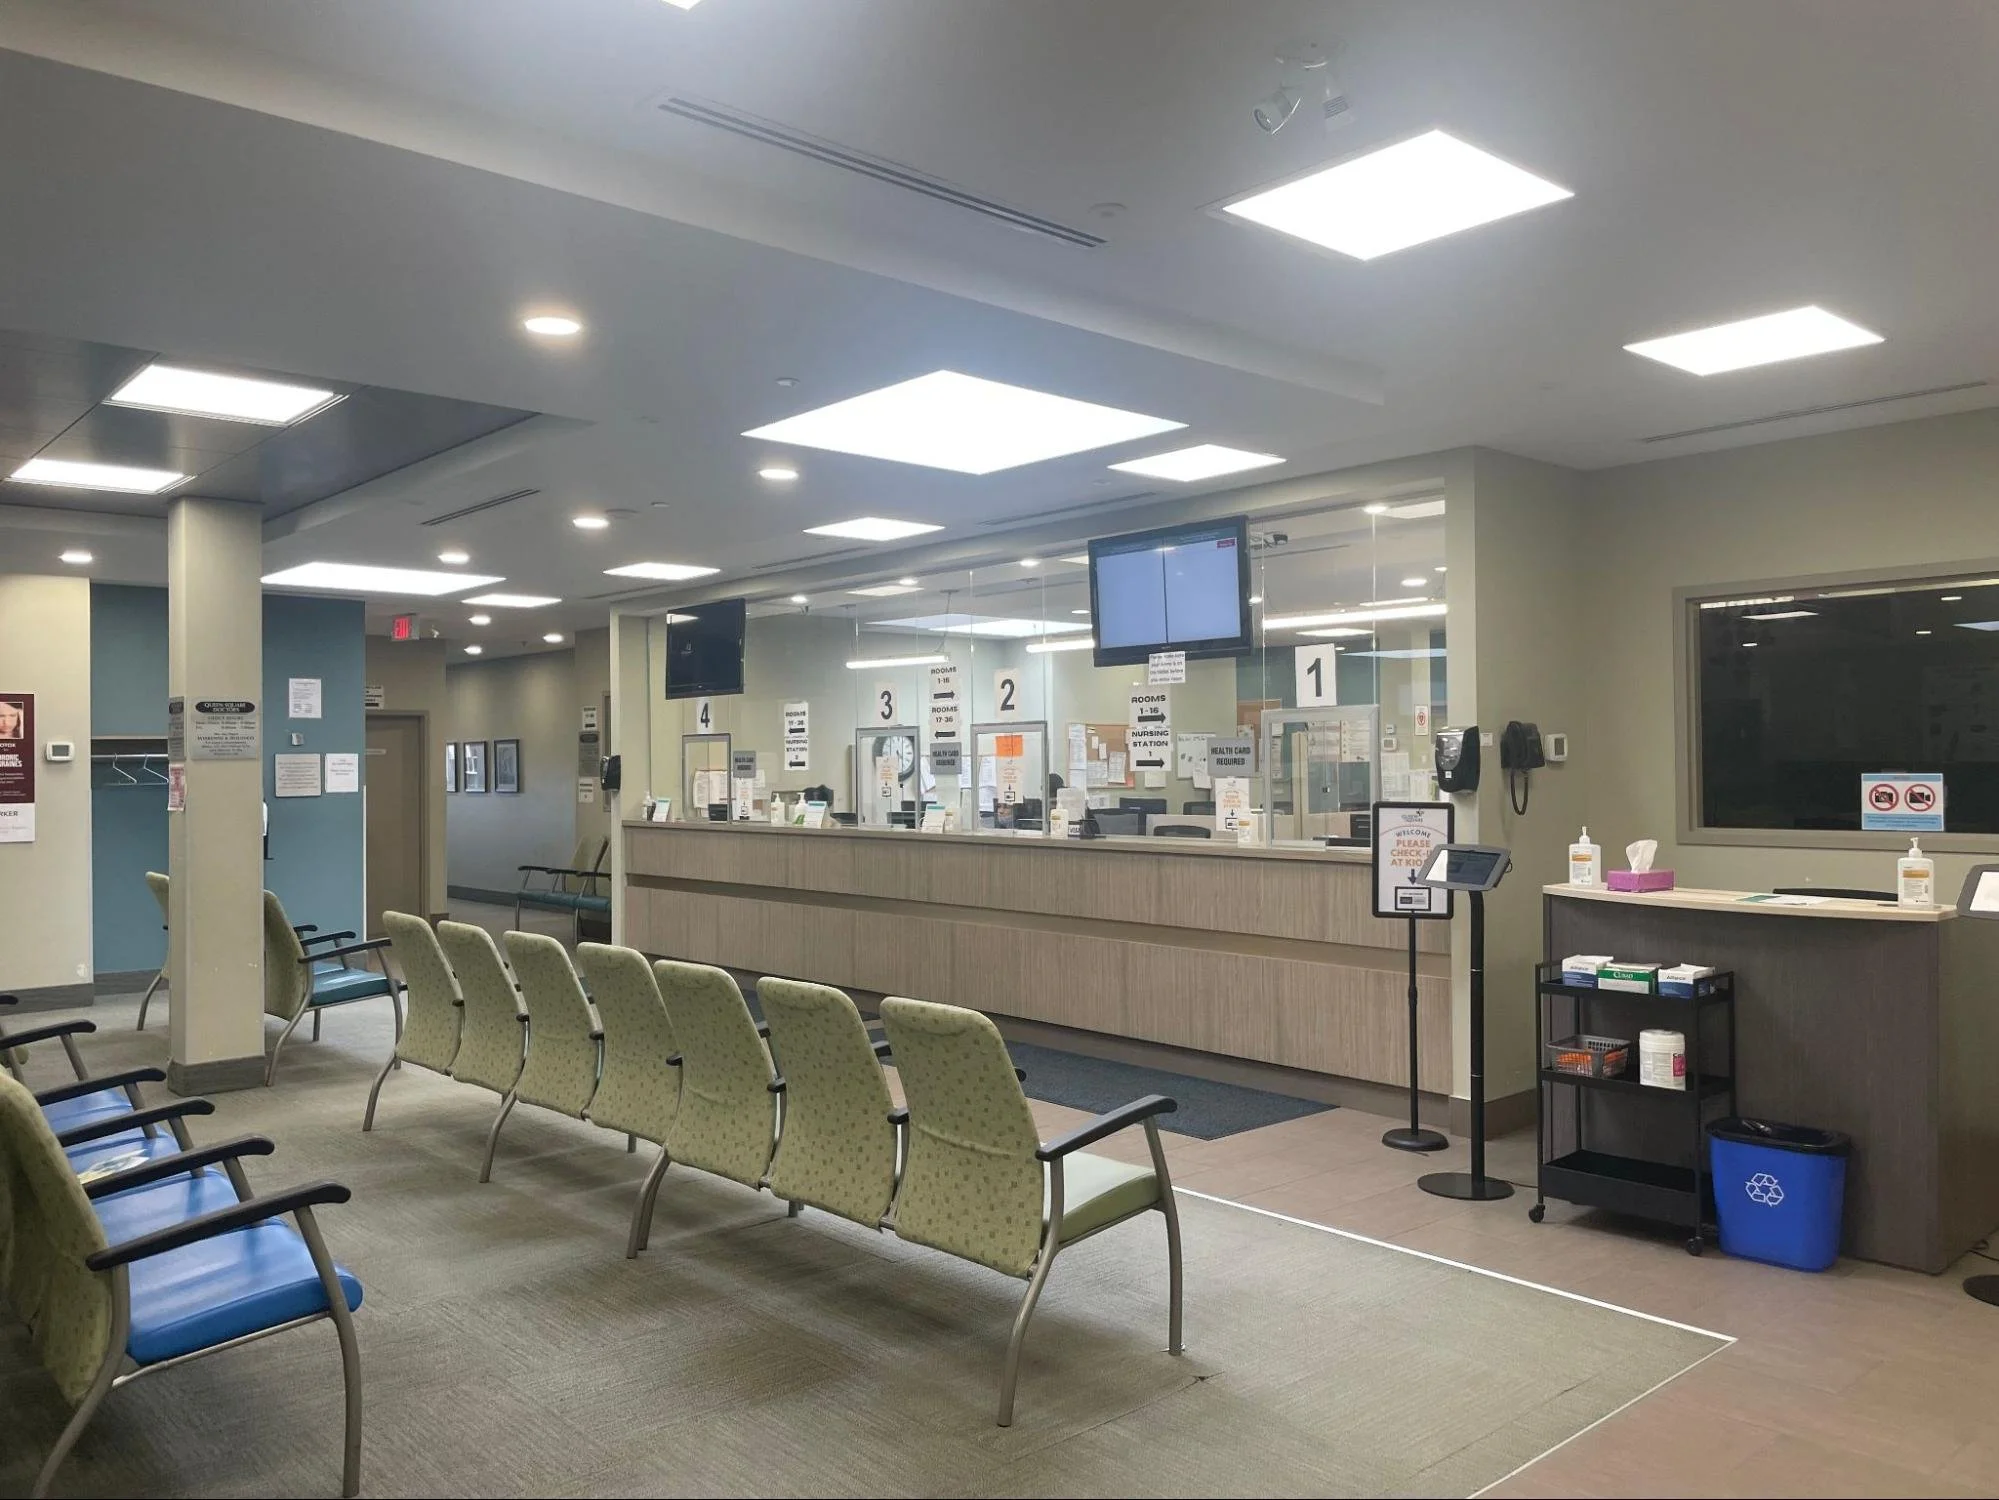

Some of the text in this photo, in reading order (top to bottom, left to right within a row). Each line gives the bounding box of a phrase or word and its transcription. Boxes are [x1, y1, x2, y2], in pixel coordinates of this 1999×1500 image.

[930, 666, 957, 675] ROOMS
[1307, 657, 1322, 697] 1
[1000, 678, 1015, 711] 2
[1131, 695, 1166, 703] ROOMS
[880, 690, 893, 720] 3
[700, 702, 710, 728] 4
[1132, 740, 1168, 748] STATION
[1211, 746, 1251, 755] HEALTH CARD
[1216, 758, 1246, 766] REQUIRED
[1395, 829, 1432, 839] WELCOME
[1396, 840, 1431, 848] PLEASE
[1390, 859, 1423, 867] AT KIO
